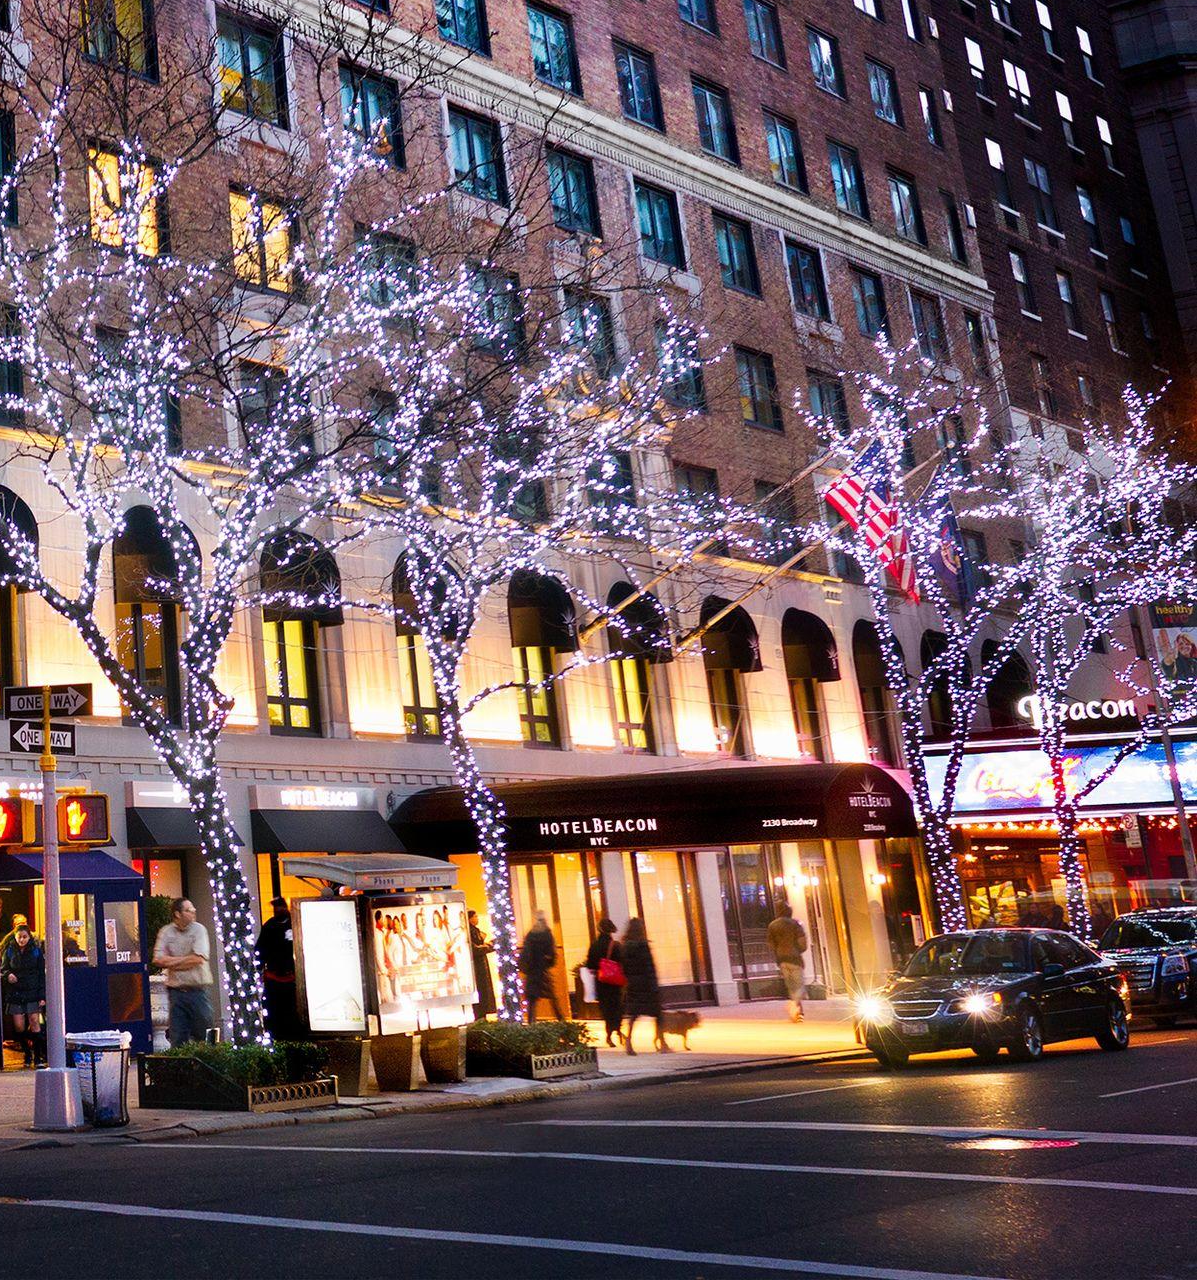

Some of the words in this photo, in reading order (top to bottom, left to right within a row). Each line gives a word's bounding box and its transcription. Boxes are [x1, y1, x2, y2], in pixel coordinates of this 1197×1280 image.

[1155, 604, 1194, 616] healthy
[17, 696, 42, 710] ONE
[53, 694, 79, 708] WAY
[20, 730, 39, 744] ONE
[50, 732, 68, 746] WAY
[762, 818, 780, 827] 2130
[781, 817, 818, 828] Broadway
[589, 837, 610, 846] NYC
[374, 876, 394, 886] Phone
[420, 874, 441, 883] Phone
[116, 951, 131, 962] EXIT
